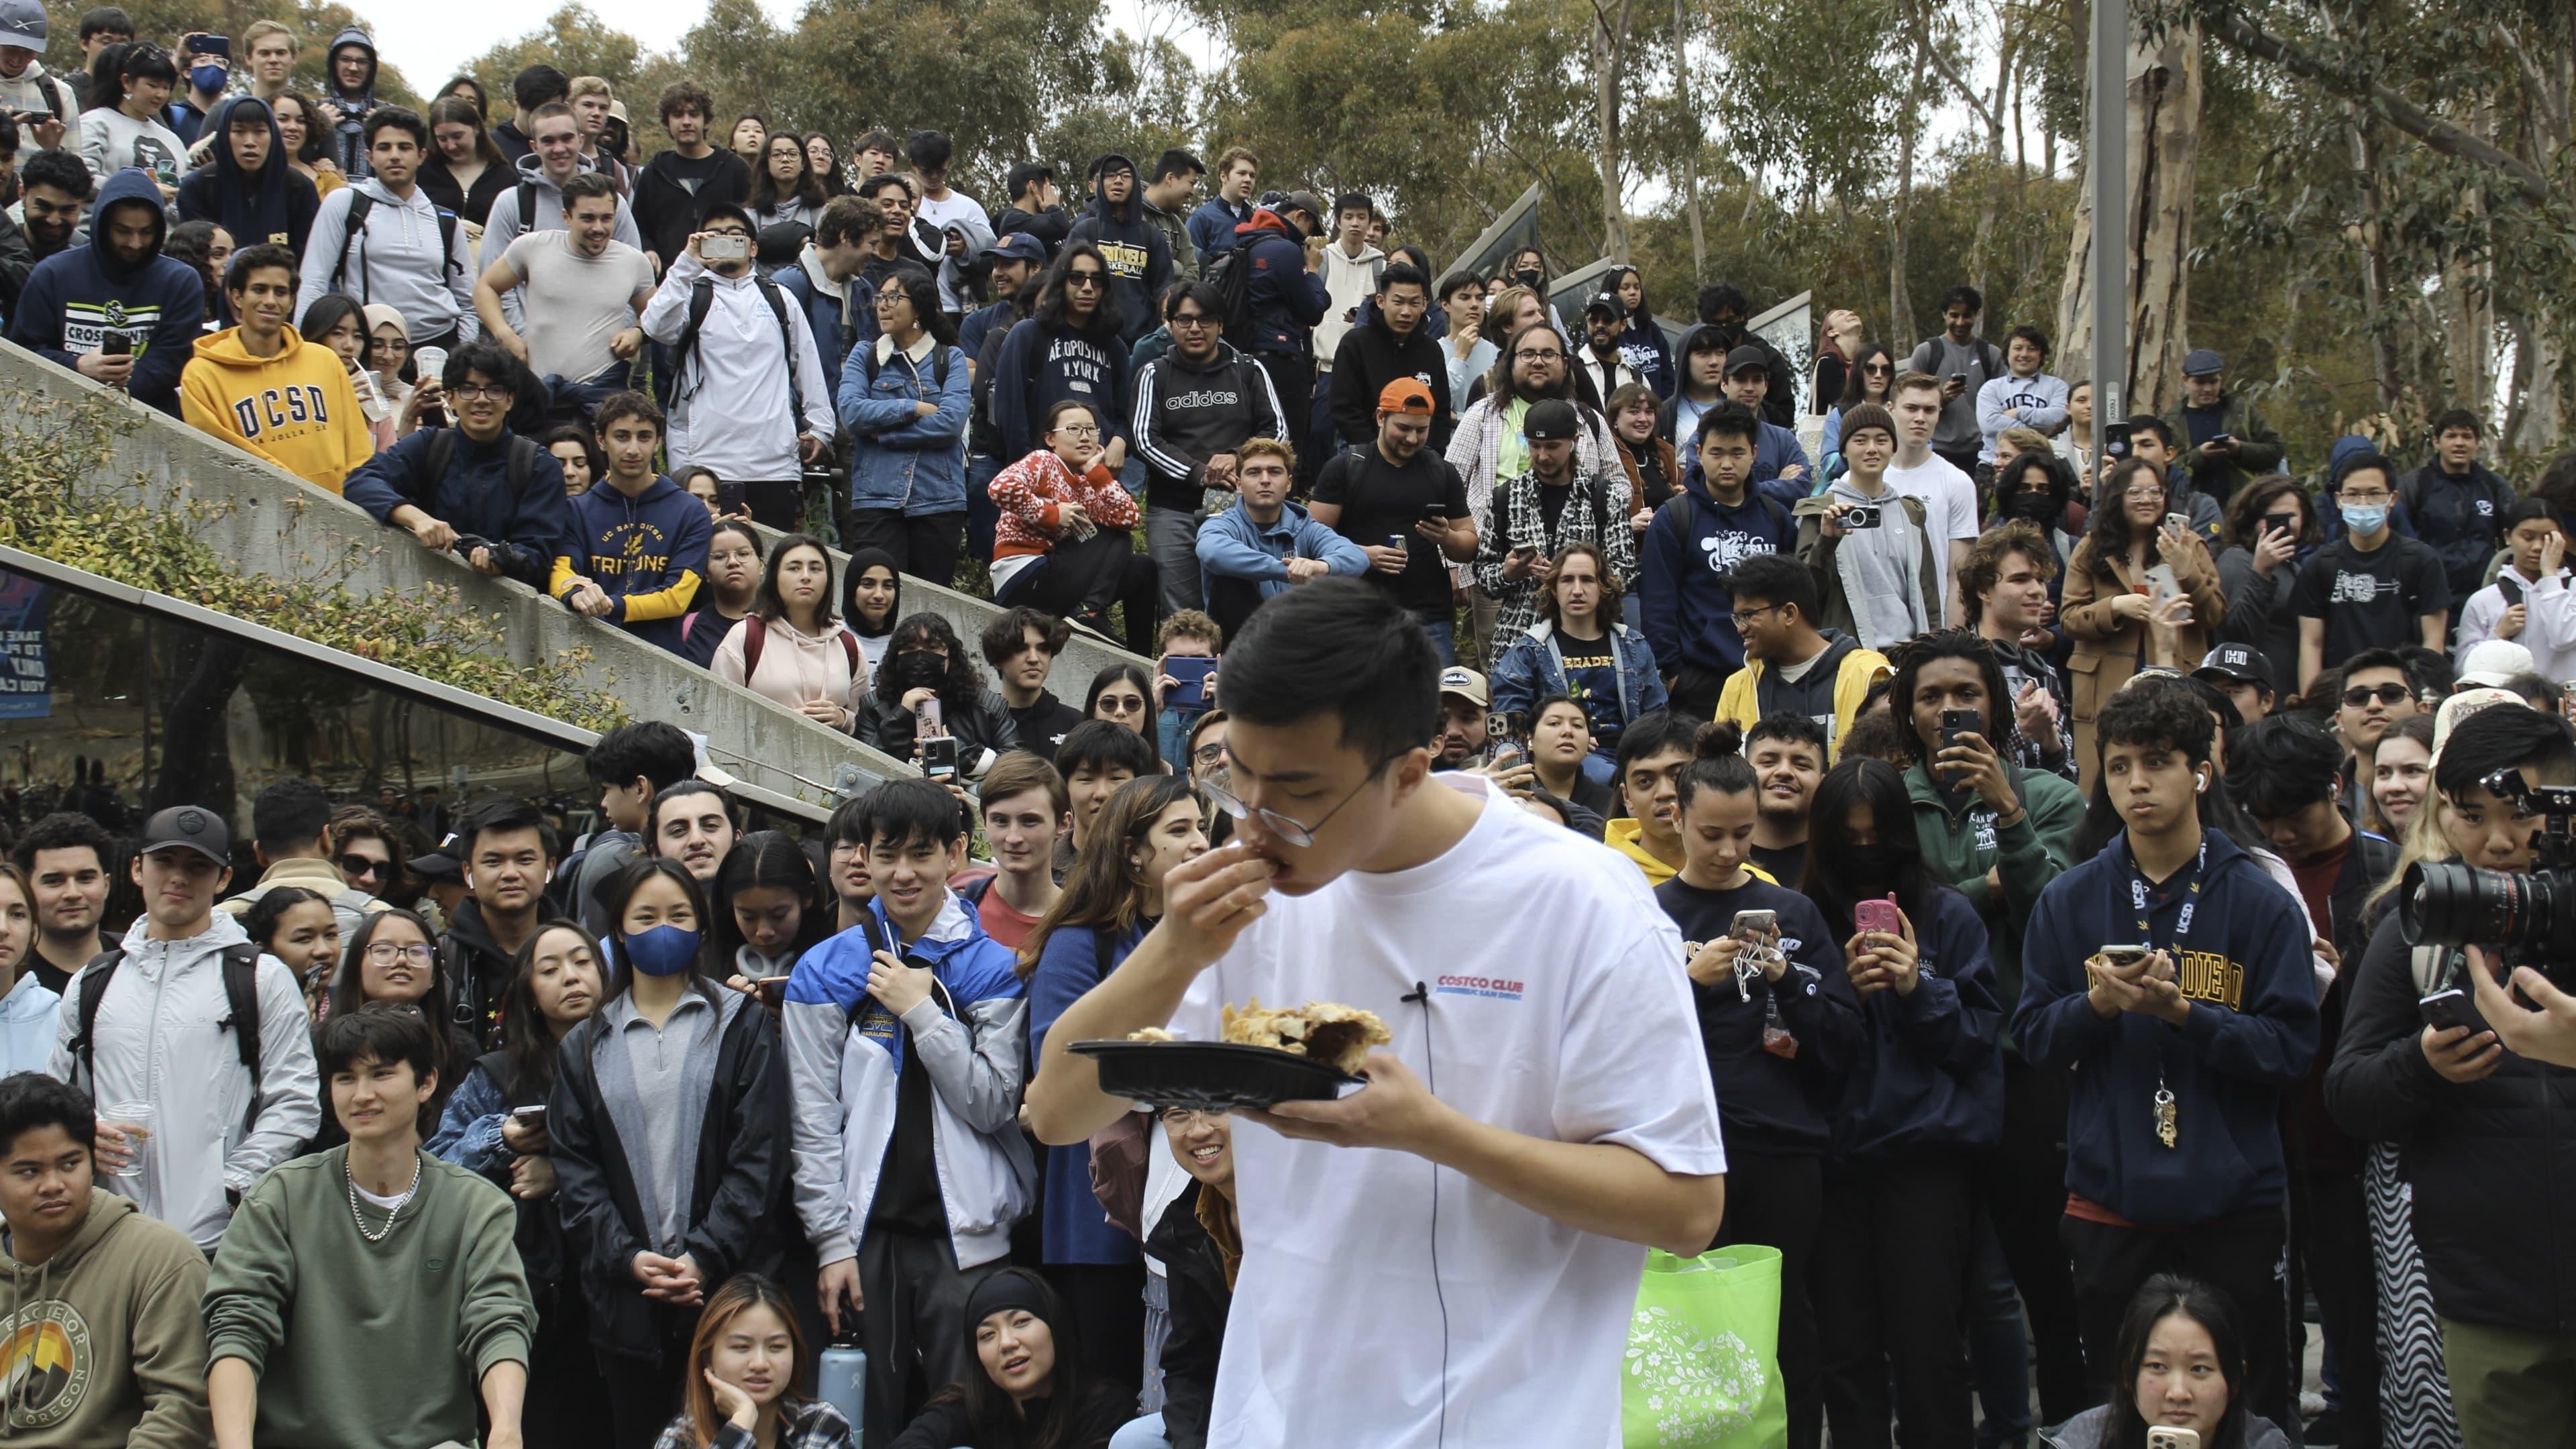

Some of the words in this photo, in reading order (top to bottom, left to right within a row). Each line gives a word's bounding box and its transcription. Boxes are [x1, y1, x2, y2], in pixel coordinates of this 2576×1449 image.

[68, 326, 103, 342] CROS
[234, 384, 328, 439] UCSD
[1165, 390, 1238, 410] adidas
[602, 531, 614, 542] UC
[2131, 879, 2145, 910] UCSD
[2176, 903, 2194, 934] UCSD
[1438, 975, 1489, 989] COSTCO
[1491, 979, 1524, 993] CLUB
[25, 1369, 86, 1438] OREGON
